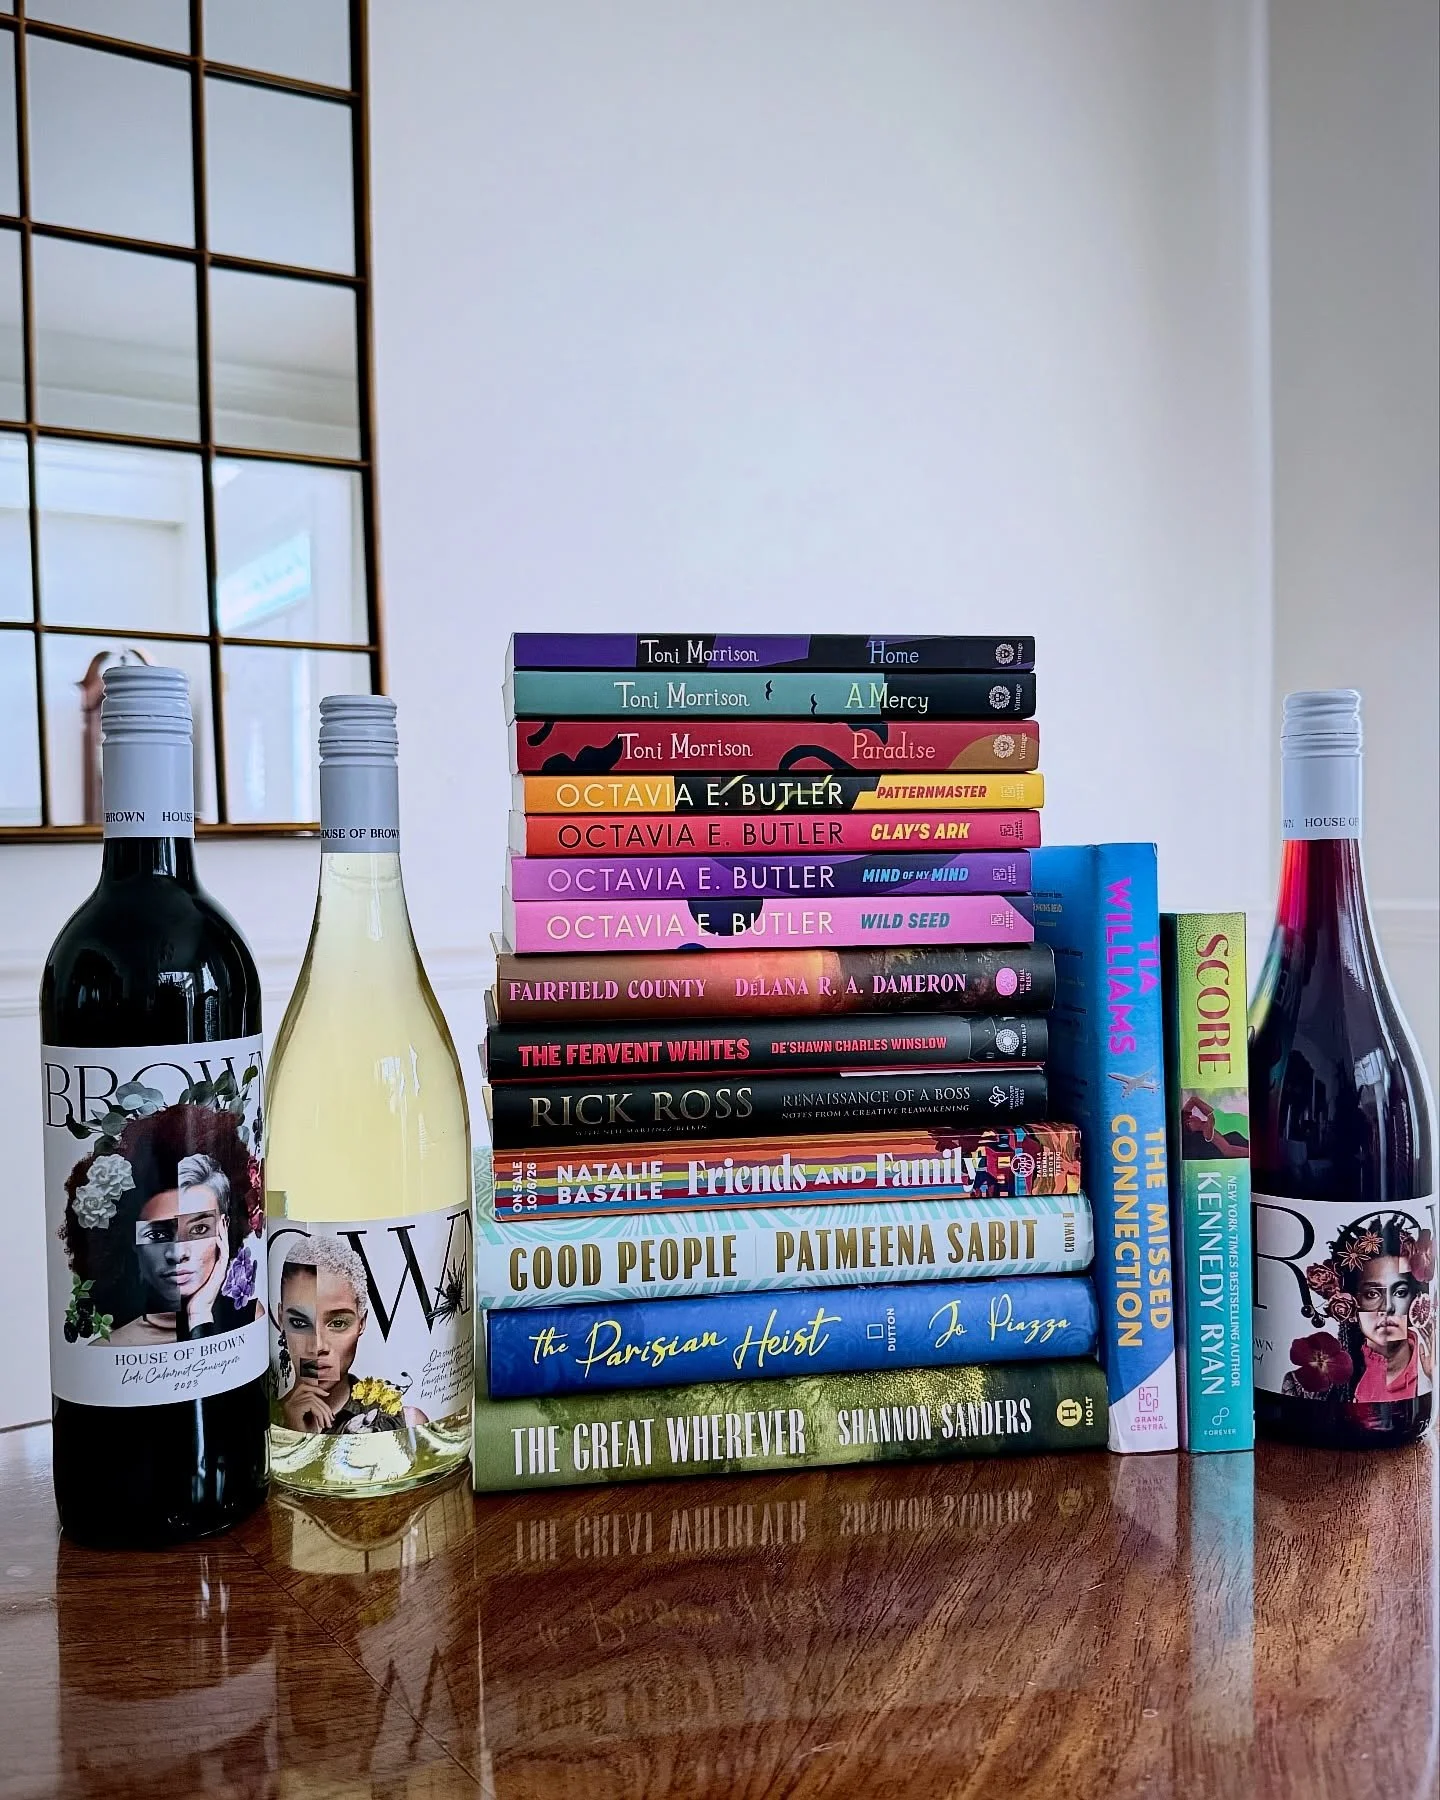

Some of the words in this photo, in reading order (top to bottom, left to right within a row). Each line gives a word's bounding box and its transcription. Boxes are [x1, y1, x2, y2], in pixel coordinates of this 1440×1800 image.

[640, 640, 680, 664] Toni
[687, 640, 759, 663] Morrison
[869, 640, 919, 664] Home
[614, 681, 659, 709] Toni
[666, 682, 750, 709] Morrison
[844, 683, 864, 708] A
[869, 683, 929, 714] Mercy
[1014, 683, 1023, 711] Vintage
[617, 733, 662, 760] Toni
[670, 732, 753, 759] Morrison
[851, 731, 936, 760] Paradise
[1019, 732, 1028, 760] Vintage
[556, 783, 694, 808] OCTAVIA
[707, 783, 729, 806] E.
[742, 782, 844, 806] BUTLER
[877, 785, 988, 799] PATTERNMASTER
[321, 828, 346, 839] OUSE
[349, 828, 367, 839] OF
[558, 823, 695, 849] OCTAVIA
[708, 823, 730, 846] E.
[743, 821, 844, 847] BUTLER
[870, 823, 930, 841] CLAY'S
[935, 822, 972, 839] ARK
[1305, 817, 1346, 828] HOUSE
[547, 868, 686, 892] OCTAVIA
[698, 867, 720, 890] E.
[733, 865, 835, 889] BUTLER
[862, 868, 900, 883] MIND
[902, 871, 915, 880] OF
[916, 871, 931, 880] MY
[930, 867, 969, 882] MIND
[547, 914, 685, 940] OCTAVIA
[697, 913, 719, 937] E.
[732, 911, 834, 936] BUTLER
[861, 913, 903, 929] WILD
[908, 912, 951, 929] SEED
[1104, 876, 1137, 1056] WILLIAMS
[1138, 936, 1160, 996] TIA
[509, 980, 619, 1002] FAIRFIELD
[627, 979, 708, 999] COUNTY
[818, 976, 837, 996] R.
[845, 975, 864, 994] A.
[872, 973, 967, 995] DAMERON
[1195, 933, 1232, 1075] SCORE
[518, 1045, 562, 1067] THE
[566, 1041, 662, 1064] FERVENT
[666, 1038, 750, 1061] WHITES
[771, 1040, 832, 1054] DE'SHAWN
[835, 1038, 888, 1052] CHARLES
[890, 1037, 947, 1050] WINSLOW
[529, 1093, 636, 1128] RICK
[651, 1087, 753, 1121] ROSS
[782, 1090, 890, 1107] RENAISSANCE
[894, 1089, 915, 1103] OF
[919, 1088, 930, 1101] A
[934, 1086, 971, 1101] BOSS
[781, 1111, 813, 1120] NOTES
[815, 1110, 841, 1118] FROM
[852, 1108, 899, 1116] CREATIVE
[901, 1104, 970, 1114] REAWAKENING
[557, 1160, 664, 1183] NATALIE
[687, 1154, 807, 1196] Friends
[814, 1164, 867, 1187] AND
[875, 1147, 984, 1193] Family
[1145, 1127, 1168, 1189] THE
[512, 1160, 523, 1190] SALE
[527, 1162, 538, 1211] 10/6/26
[1227, 1175, 1237, 1203] NEW
[512, 1192, 523, 1214] ON
[557, 1181, 663, 1205] BASZILE
[1111, 1114, 1143, 1347] CONNECTION
[1228, 1204, 1238, 1232] YORK
[775, 1223, 936, 1274] PATMEENA
[947, 1219, 1038, 1264] SABIT
[1063, 1221, 1075, 1253] CROWN
[1197, 1172, 1225, 1312] KENNEDY
[1229, 1234, 1239, 1268] TIMES
[509, 1243, 602, 1292] GOOD
[617, 1235, 738, 1284] PEOPLE
[1146, 1203, 1173, 1330] MISSED
[1229, 1271, 1240, 1341] BESTSELLING
[887, 1308, 896, 1352] DUTTON
[928, 1300, 968, 1348] Jo
[987, 1293, 1071, 1344] Piazza
[115, 1351, 168, 1366] HOUSE
[173, 1347, 195, 1361] OF
[200, 1334, 246, 1357] BROWN
[528, 1326, 569, 1364] the
[575, 1320, 728, 1378] Parisian
[733, 1308, 842, 1370] Heist
[1200, 1324, 1226, 1395] RYAN
[1230, 1342, 1241, 1387] AUTHOR
[174, 1380, 199, 1391] 2023
[837, 1404, 932, 1446] SHANNON
[941, 1397, 1032, 1440] SANDERS
[1085, 1396, 1094, 1427] HOLT
[1134, 1415, 1164, 1423] GRAND
[1130, 1423, 1168, 1432] CENTRAL
[1204, 1428, 1237, 1436] FOREVER
[510, 1425, 561, 1476] THE
[573, 1418, 655, 1472] GREAT
[666, 1409, 806, 1464] WHEREVER
